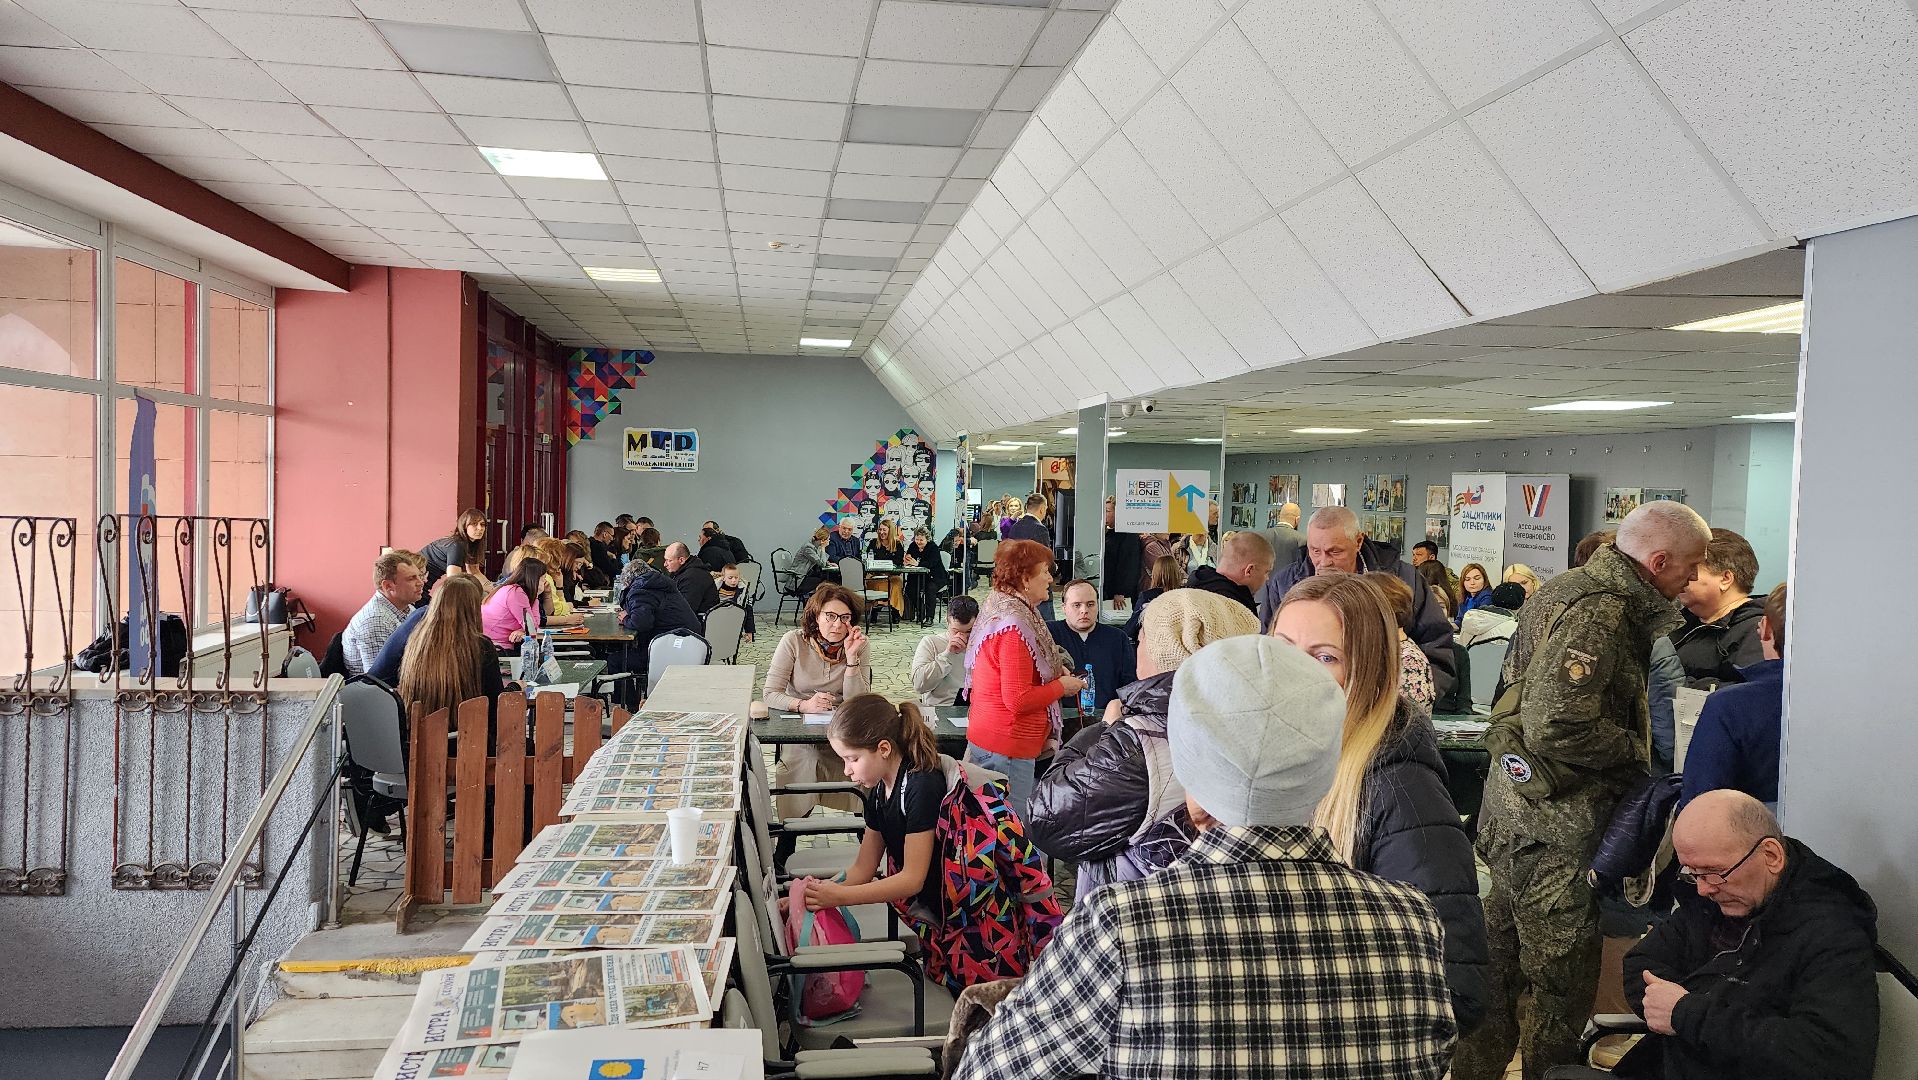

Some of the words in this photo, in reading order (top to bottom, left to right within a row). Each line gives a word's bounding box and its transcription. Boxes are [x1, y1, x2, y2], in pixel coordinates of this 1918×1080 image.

[1462, 510, 1502, 521] ЗАЩИТНИКИ
[1461, 521, 1496, 531] ОТЕЧЕСТВА
[481, 923, 512, 948] ИСТРА
[424, 1010, 451, 1044] ИСТРА
